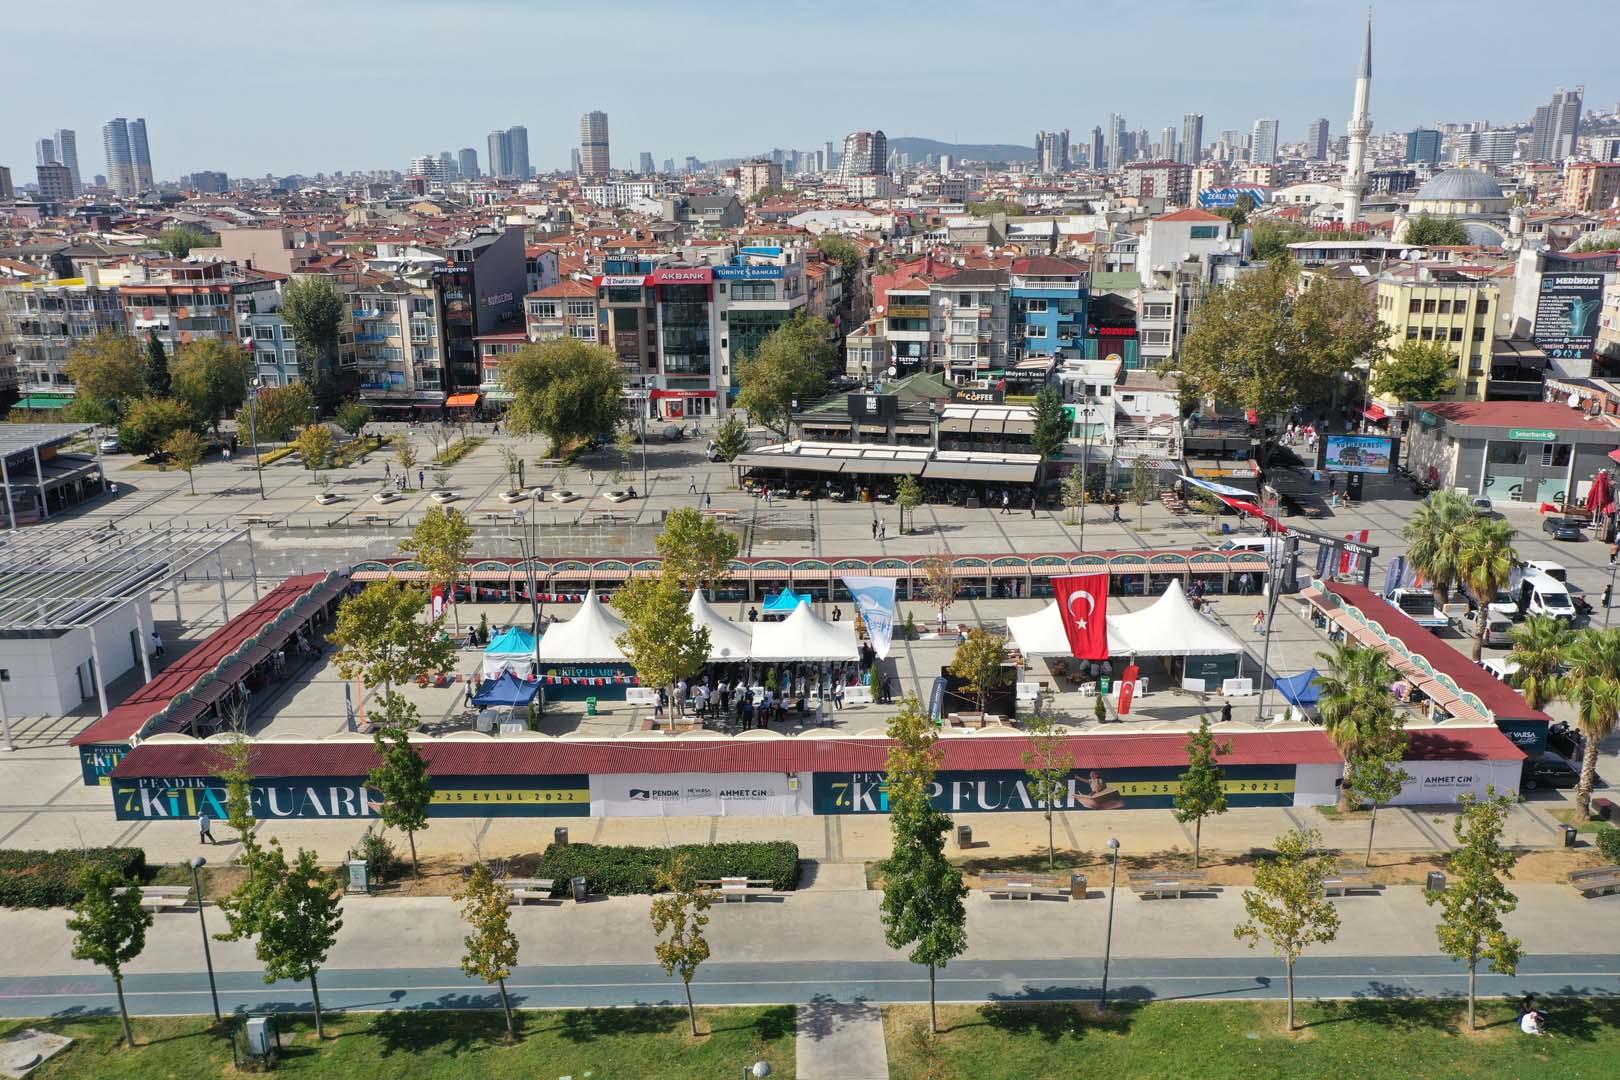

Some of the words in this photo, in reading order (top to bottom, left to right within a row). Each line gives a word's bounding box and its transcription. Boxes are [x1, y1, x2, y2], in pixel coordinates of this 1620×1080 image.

[965, 391, 994, 401] COFFEE
[1424, 776, 1456, 784] AHMET
[1121, 785, 1137, 793] 16
[1152, 784, 1169, 792] 25
[1240, 783, 1280, 791] 2022
[719, 789, 750, 797] AHMET
